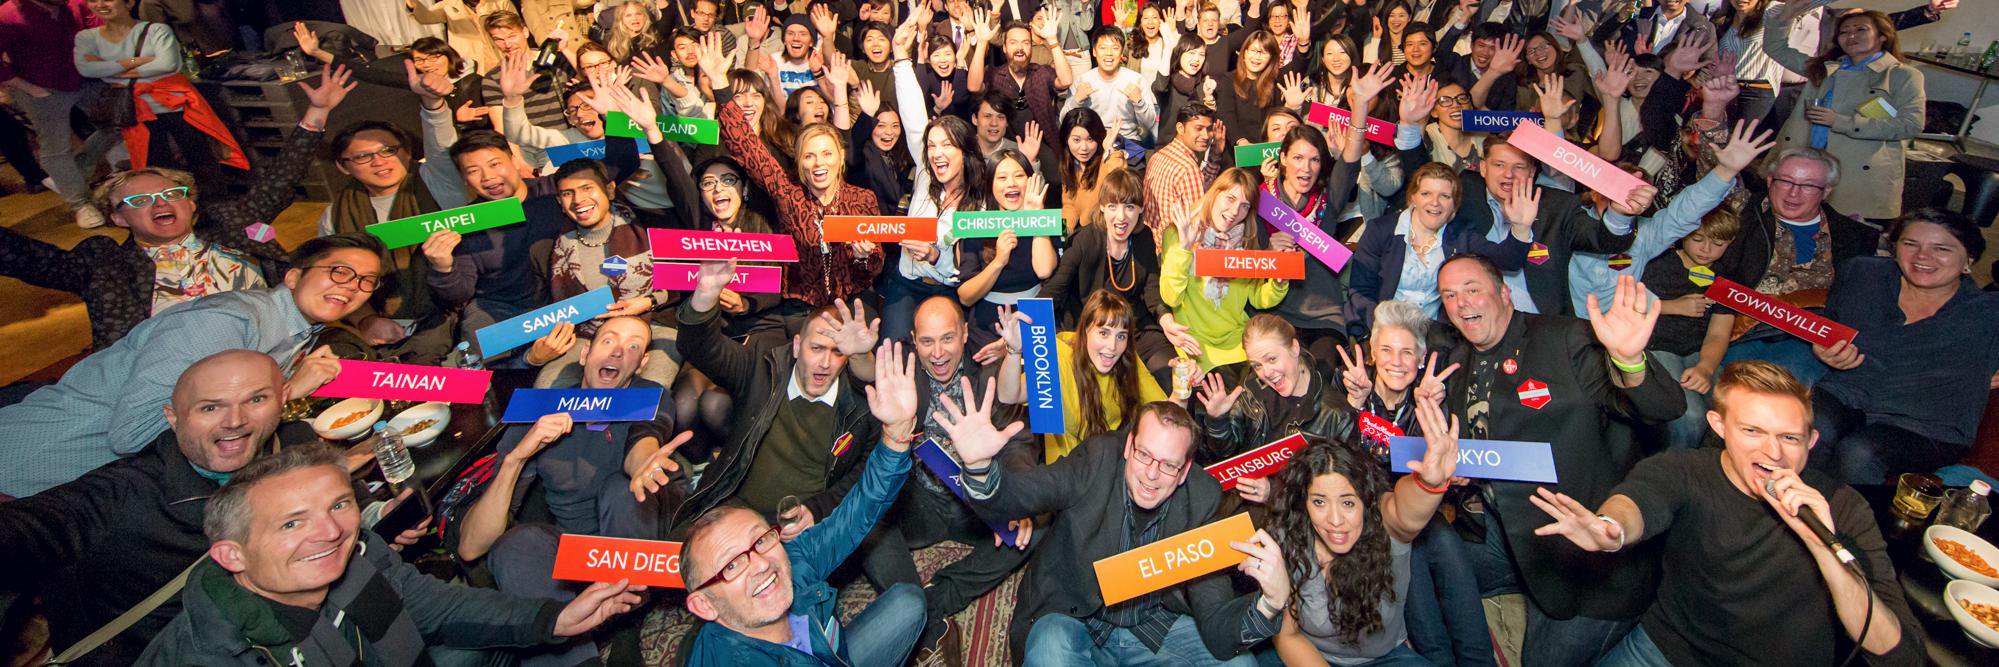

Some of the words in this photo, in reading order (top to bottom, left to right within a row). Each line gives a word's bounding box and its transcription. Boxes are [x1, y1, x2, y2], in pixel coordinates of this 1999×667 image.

[628, 118, 698, 136] POTLAND
[1329, 112, 1380, 135] BRISNE
[1474, 115, 1510, 127] HONG
[580, 145, 606, 157] AKA
[1262, 146, 1281, 159] KYO
[1553, 146, 1602, 178] BONN
[421, 212, 476, 233] TAIPEI
[856, 223, 906, 235] CAIRNS
[957, 216, 1057, 230] CHRISTCHURCH
[1271, 206, 1288, 221] ST
[1285, 216, 1330, 254] JOSEPH
[681, 236, 773, 252] SHENZHEN
[1224, 256, 1277, 270] IZHEVSK
[687, 270, 749, 284] MAT
[522, 304, 579, 333] SANA'A
[1727, 287, 1832, 338] TOWNSVILLE
[1030, 325, 1054, 409] BROOKLYN
[371, 371, 446, 391] TAINAN
[557, 396, 612, 411] MIAMI
[1219, 447, 1294, 484] LENSBURG
[1456, 448, 1501, 467] KYO
[586, 548, 629, 570] SAN
[633, 552, 680, 574] DIEG
[1138, 556, 1163, 579] EL
[1164, 539, 1215, 571] PASO
